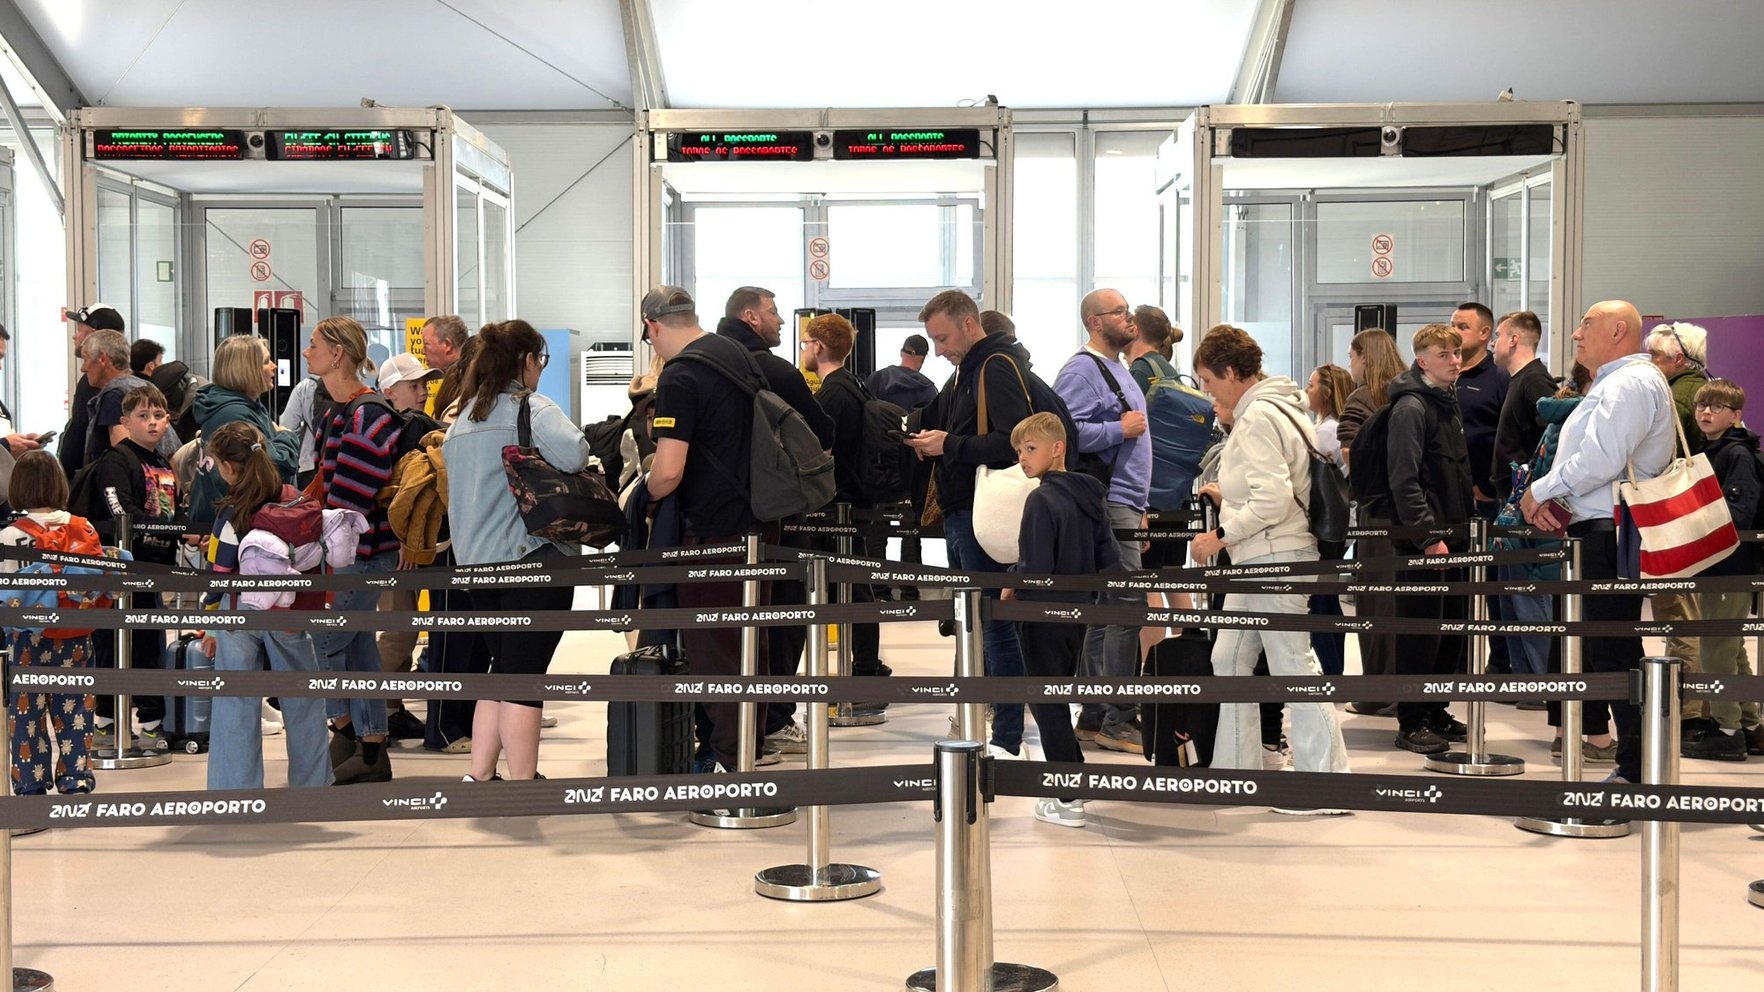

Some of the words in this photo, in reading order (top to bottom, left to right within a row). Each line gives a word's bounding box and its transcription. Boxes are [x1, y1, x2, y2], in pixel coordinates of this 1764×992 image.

[702, 546, 747, 555] AEROPORTO
[836, 557, 881, 567] AEROPORTO
[1448, 554, 1493, 563] AEROPORTO
[81, 559, 126, 569] AEROPORTO
[496, 562, 543, 571] AEROPORTO
[733, 567, 787, 576] AEROPORTO
[1244, 566, 1290, 574] AEROPORTO
[12, 578, 67, 587] AEROPORTO
[258, 579, 312, 587] AEROPORTO
[473, 576, 496, 584] FARO
[498, 574, 551, 583] AEROPORTO
[892, 573, 915, 581] FARO
[917, 574, 970, 583] AEROPORTO
[1154, 582, 1207, 590] AEROPORTO
[1614, 582, 1638, 590] FARO
[1640, 581, 1696, 590] AEROPORTO
[151, 615, 179, 624] FARO
[181, 615, 246, 625] AEROPORTO
[437, 617, 465, 626] FARO
[467, 616, 531, 626] AEROPORTO
[721, 612, 748, 621] FARO
[751, 611, 816, 621] AEROPORTO
[1173, 614, 1201, 623] FARO
[1204, 615, 1269, 626] AEROPORTO
[1499, 625, 1566, 633] AEROPORTO
[12, 672, 95, 687] AEROPORTO
[342, 679, 377, 691] FARO
[380, 681, 462, 692] AEROPORTO
[708, 683, 742, 694] FARO
[747, 683, 828, 695] AEROPORTO
[1077, 684, 1112, 695] FARO
[1117, 685, 1200, 696] AEROPORTO
[1459, 682, 1495, 693] FARO
[1499, 681, 1587, 693] AEROPORTO
[1088, 774, 1137, 790] FARO
[1142, 777, 1257, 795] AEROPORTO
[610, 786, 658, 801] FARO
[664, 782, 777, 800] AEROPORTO
[1376, 788, 1420, 798] VINCI
[382, 797, 426, 807] VINCI
[1611, 794, 1661, 809] FARO
[1666, 797, 1764, 812] AEROPORT
[97, 801, 146, 817] FARO
[150, 799, 266, 816] AEROPORTO
